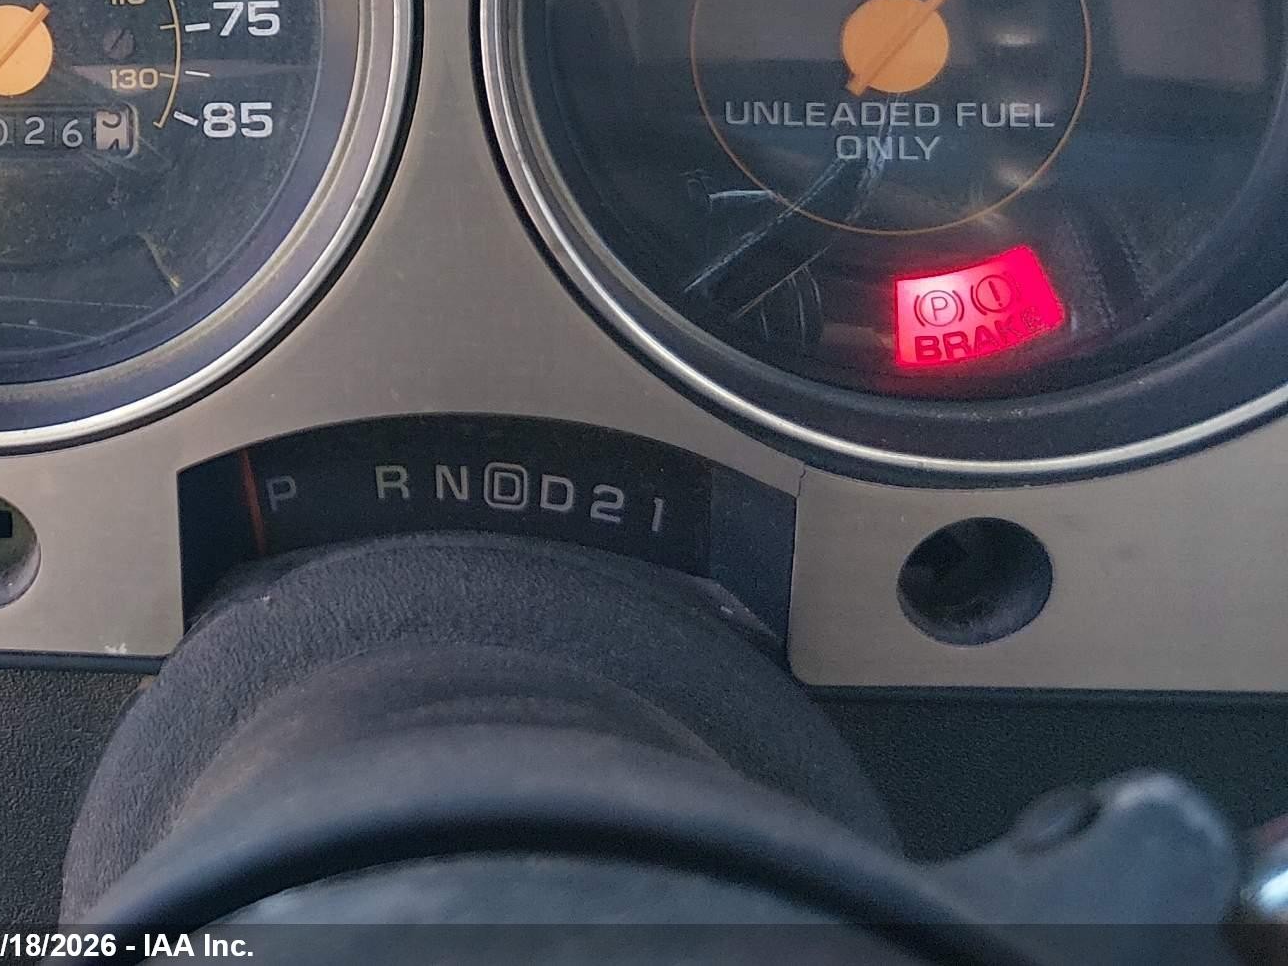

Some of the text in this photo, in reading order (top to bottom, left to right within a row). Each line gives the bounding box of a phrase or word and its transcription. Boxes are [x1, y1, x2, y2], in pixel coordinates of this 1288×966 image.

[212, 0, 281, 36] 75
[110, 68, 158, 90] 130
[202, 101, 273, 138] 85
[724, 100, 1056, 128] UNLEADED FUEL
[835, 135, 941, 161] ONLY
[914, 306, 1042, 362] BRAK
[265, 474, 298, 514] P
[374, 464, 410, 501] R
[435, 464, 469, 501] N
[539, 474, 575, 513] D
[590, 484, 626, 524] 2
